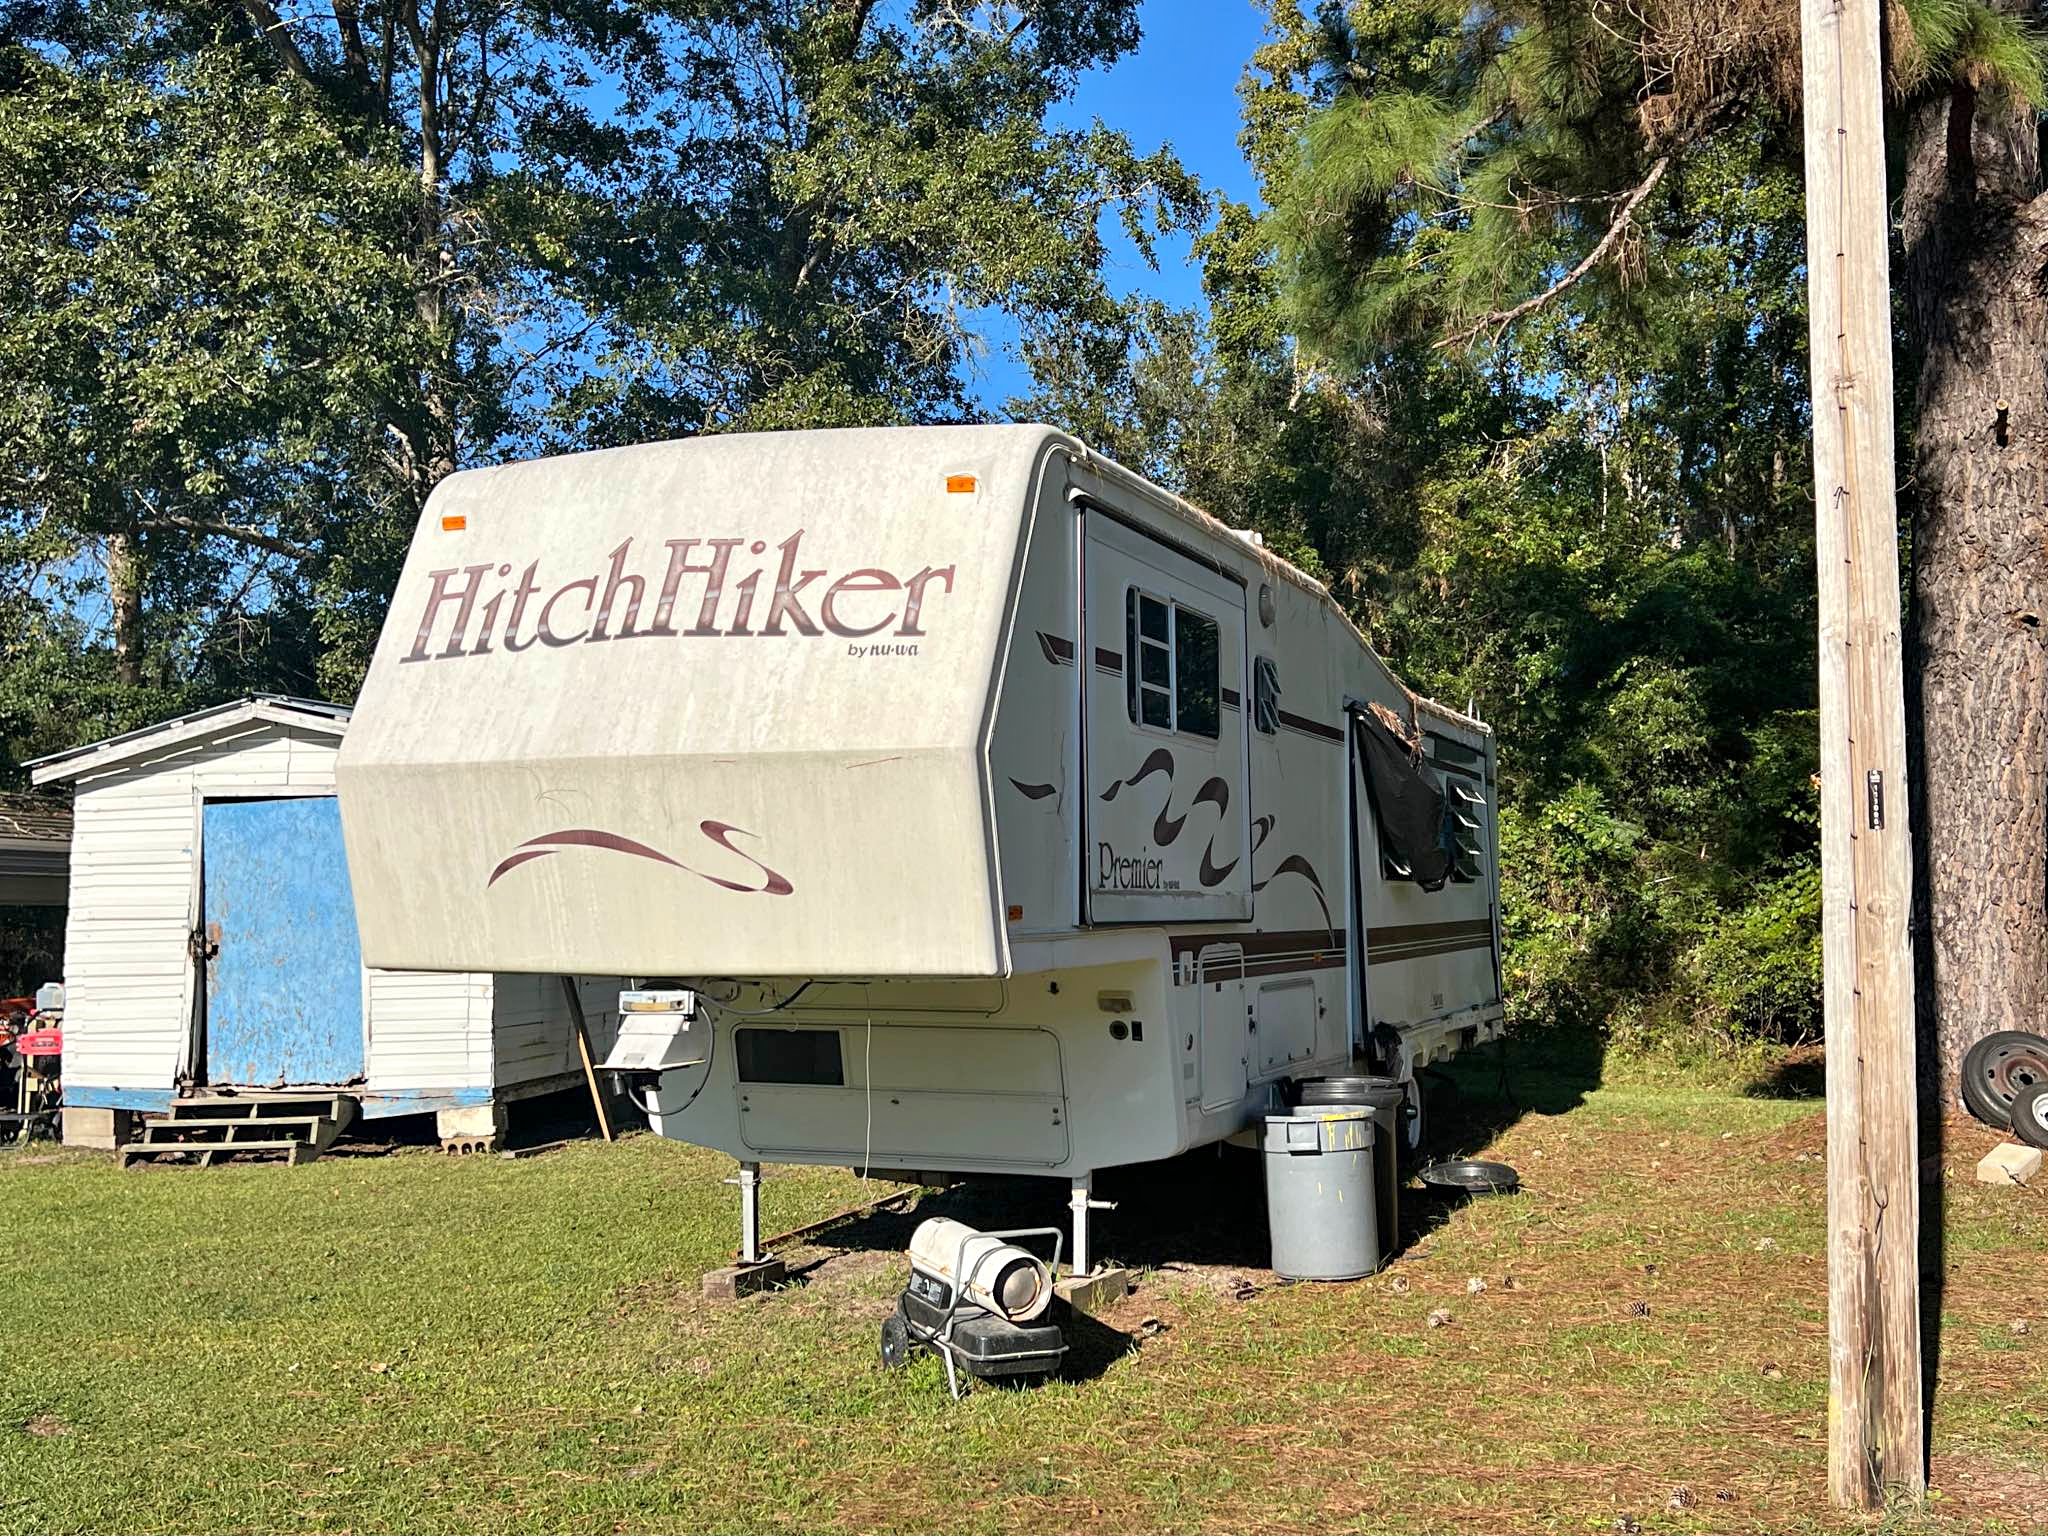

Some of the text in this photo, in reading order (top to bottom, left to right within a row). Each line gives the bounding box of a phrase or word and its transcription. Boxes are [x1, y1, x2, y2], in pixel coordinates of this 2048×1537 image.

[399, 527, 957, 665] HitchHiker
[847, 643, 868, 658] by
[1098, 841, 1163, 890] Premier
